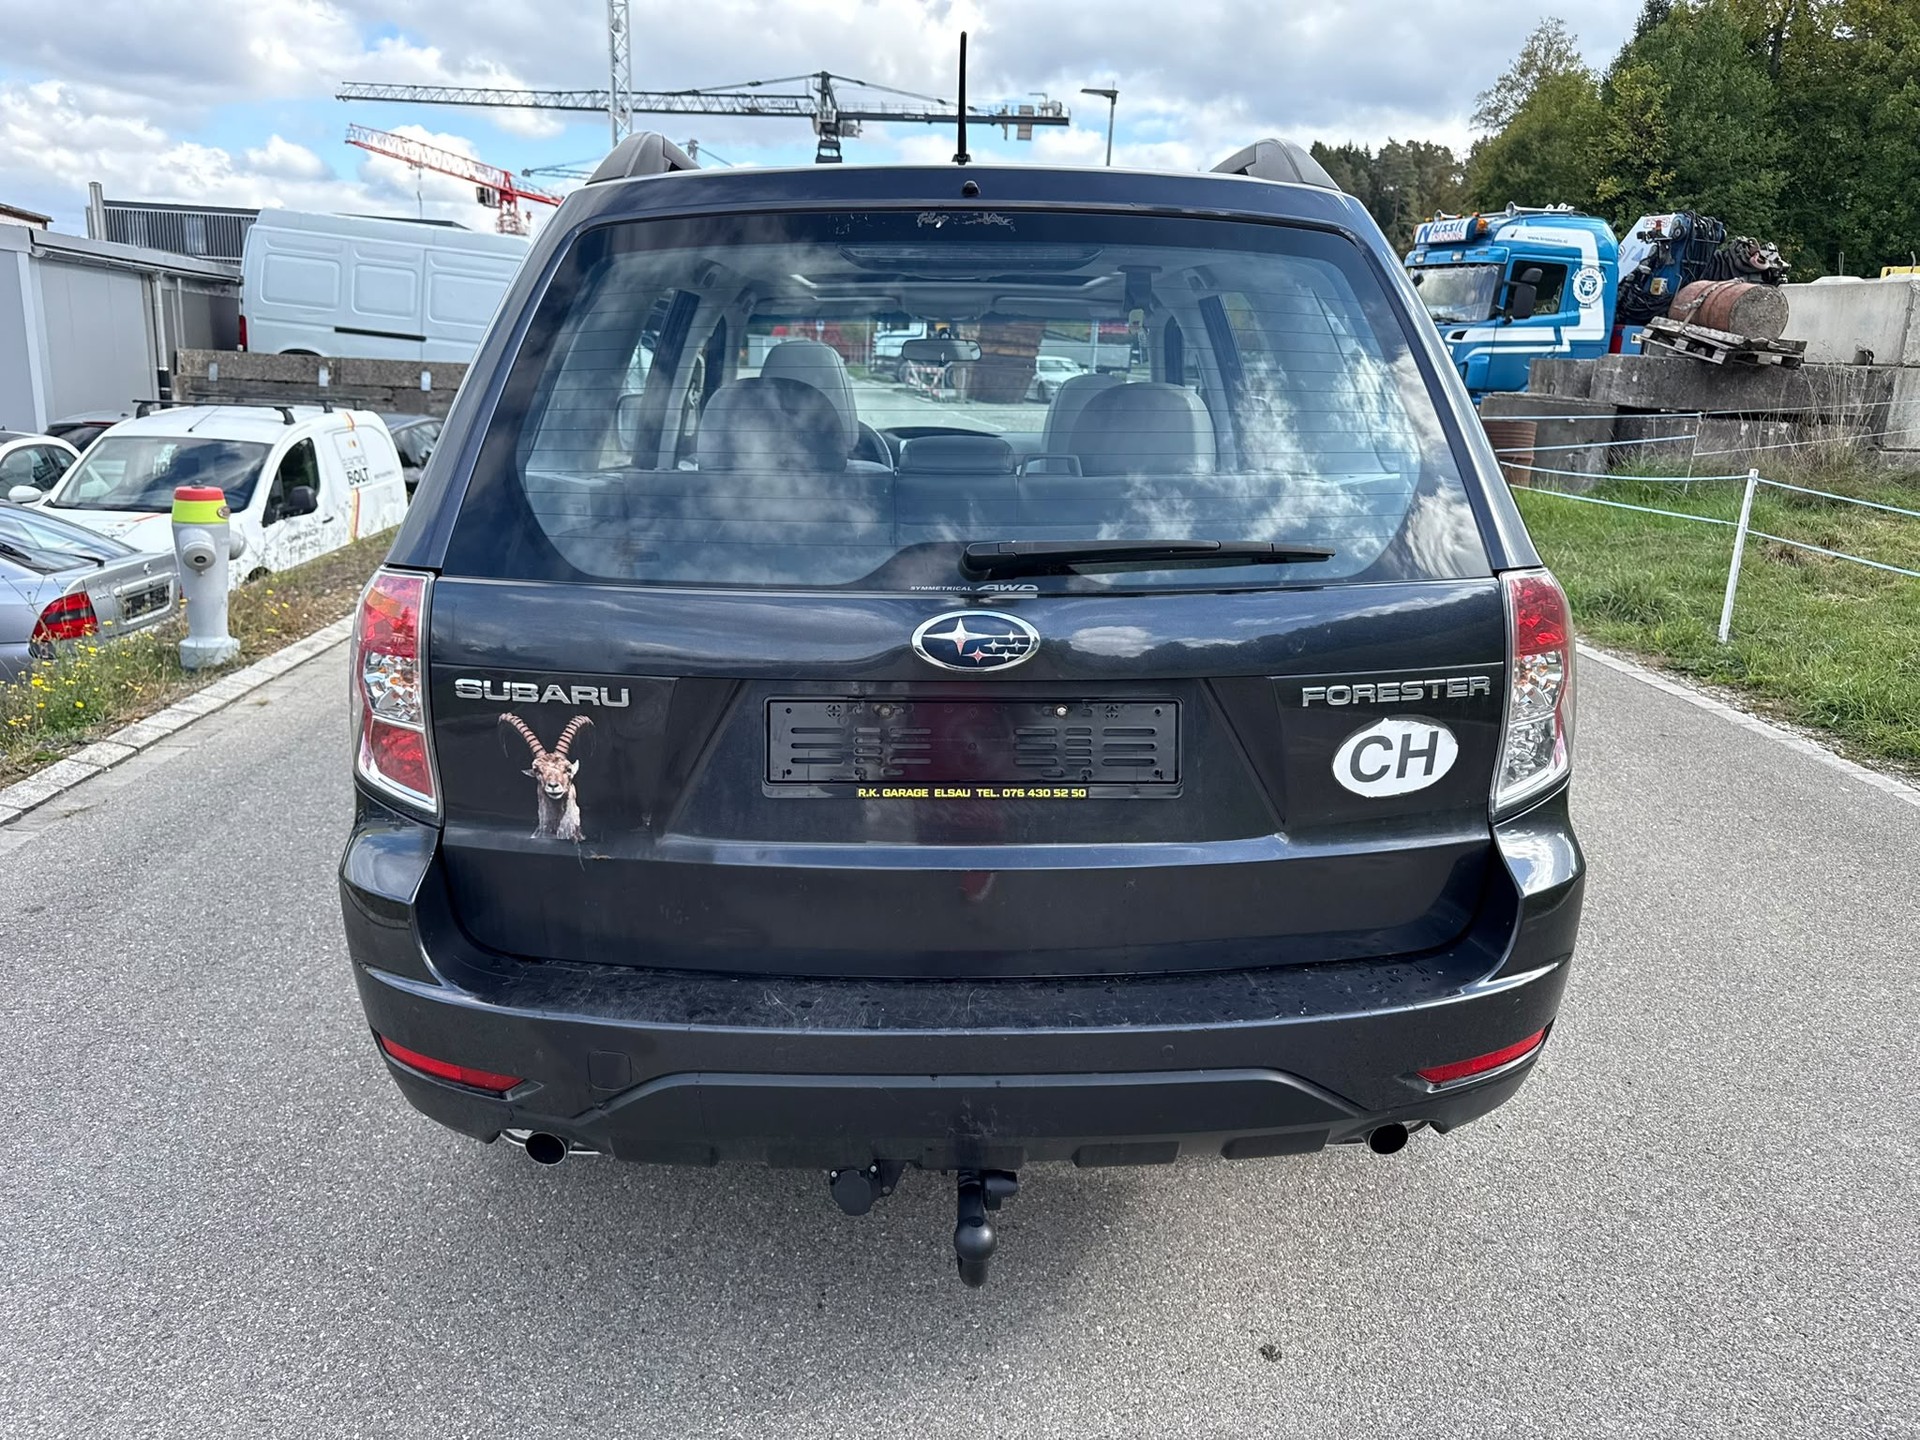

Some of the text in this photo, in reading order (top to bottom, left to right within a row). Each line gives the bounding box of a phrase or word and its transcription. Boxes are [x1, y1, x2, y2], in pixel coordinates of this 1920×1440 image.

[346, 467, 369, 486] BOLT
[976, 584, 1039, 592] AWD
[454, 678, 630, 708] SUBARU
[1302, 676, 1491, 707] FORESTER
[1350, 731, 1439, 783] CH
[858, 788, 1087, 797] R.K. GARAGE ELSAU TEL. 076 430 52 50
